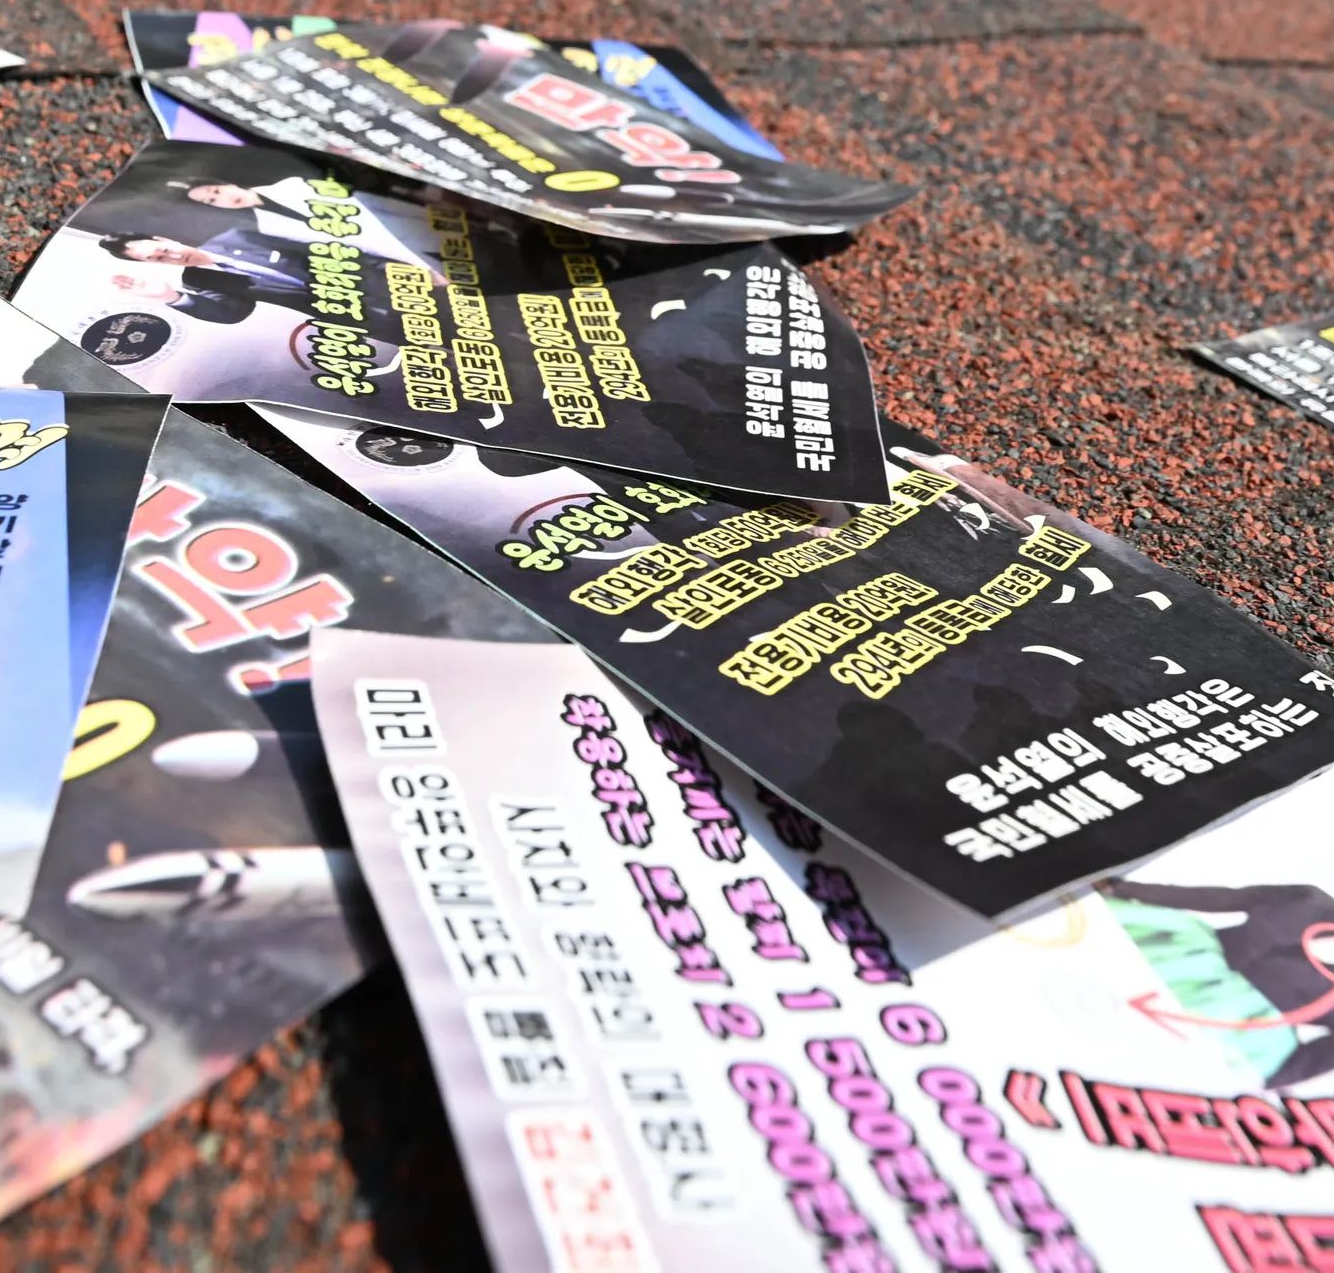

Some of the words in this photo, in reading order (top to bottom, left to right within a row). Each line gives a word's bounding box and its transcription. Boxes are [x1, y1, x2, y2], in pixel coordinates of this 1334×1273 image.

[745, 266, 782, 356] 해외행각은
[400, 347, 458, 413] 해외행각
[452, 339, 512, 404] 살인로동
[535, 347, 605, 429] 전용기비용
[589, 346, 651, 402] 294년의
[745, 367, 786, 438] 윤석열의
[791, 381, 835, 471] 국민혈세를
[496, 494, 629, 572] 윤석열이
[571, 546, 693, 619] 해외행각
[683, 528, 753, 558] 1회당
[650, 563, 784, 630] 살인로동
[829, 517, 889, 551] 해야
[889, 470, 958, 506] 혈세
[719, 594, 873, 696] 전용기비용
[831, 628, 959, 700] 294년의
[904, 594, 1012, 644] 등록금에
[980, 564, 1052, 607] 해당한
[1018, 526, 1093, 571] 혈세
[366, 686, 438, 752] 마리
[944, 738, 1108, 813] 윤석열의
[1100, 679, 1258, 752] 해외행각은
[944, 775, 1140, 863] 국민혈세를
[1124, 700, 1321, 788] 공중살포하는
[560, 693, 654, 849] 착용하는
[626, 861, 735, 986] 브로치
